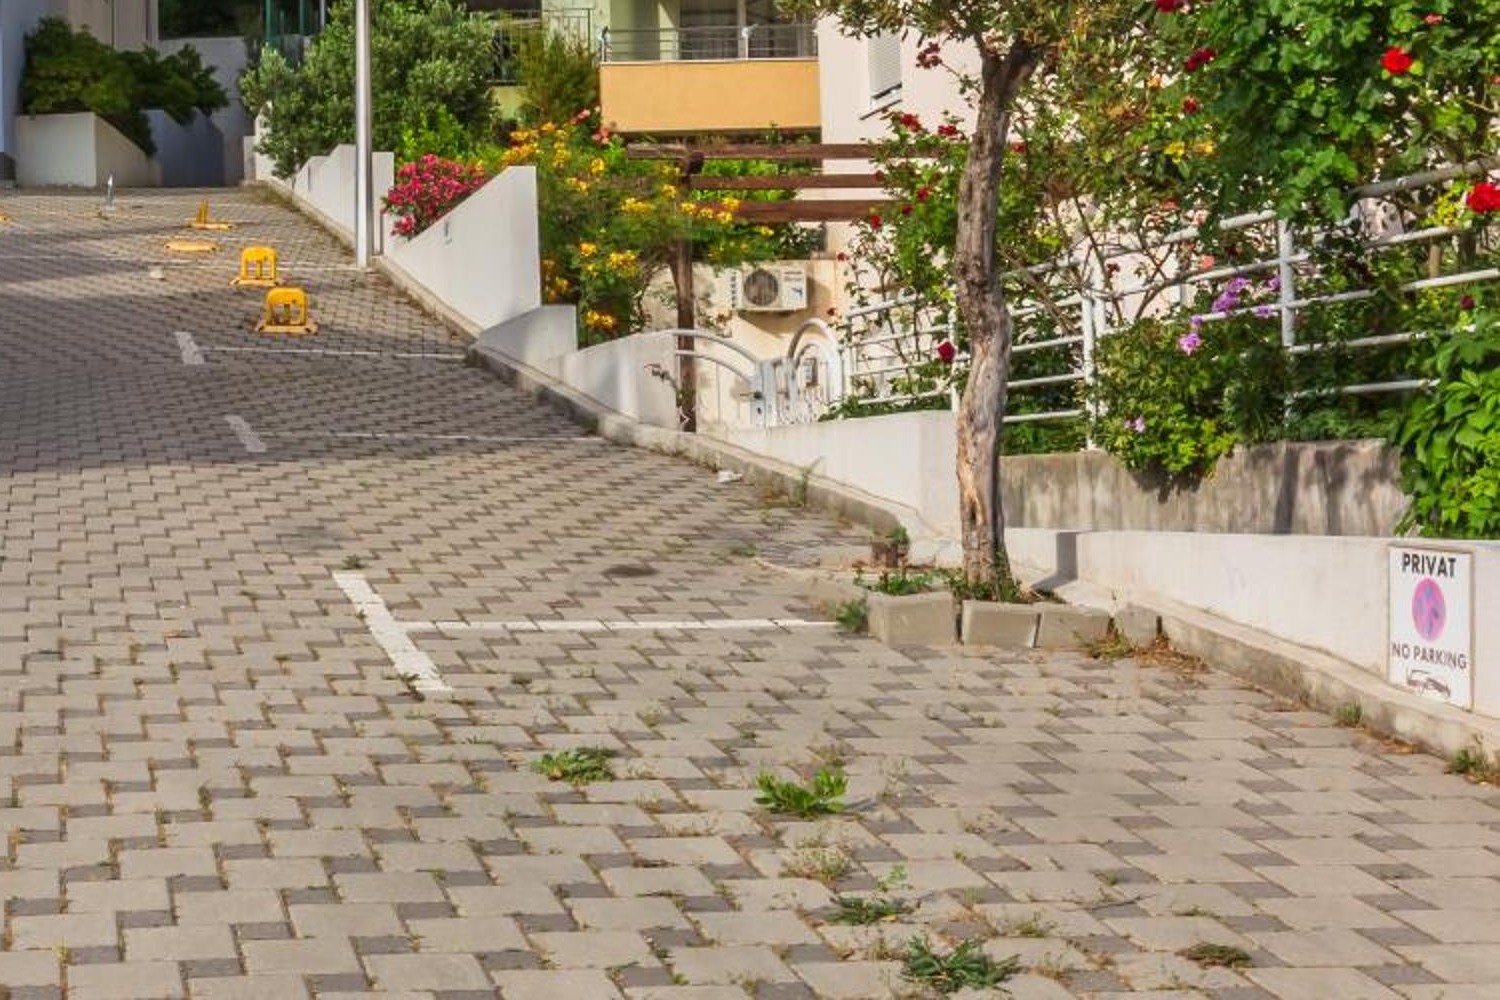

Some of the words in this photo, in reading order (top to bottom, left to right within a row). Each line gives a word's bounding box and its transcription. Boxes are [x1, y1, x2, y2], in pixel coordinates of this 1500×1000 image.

[1402, 553, 1457, 578] PRIVAT
[1392, 643, 1411, 660] NO
[1414, 645, 1467, 670] PARKING
